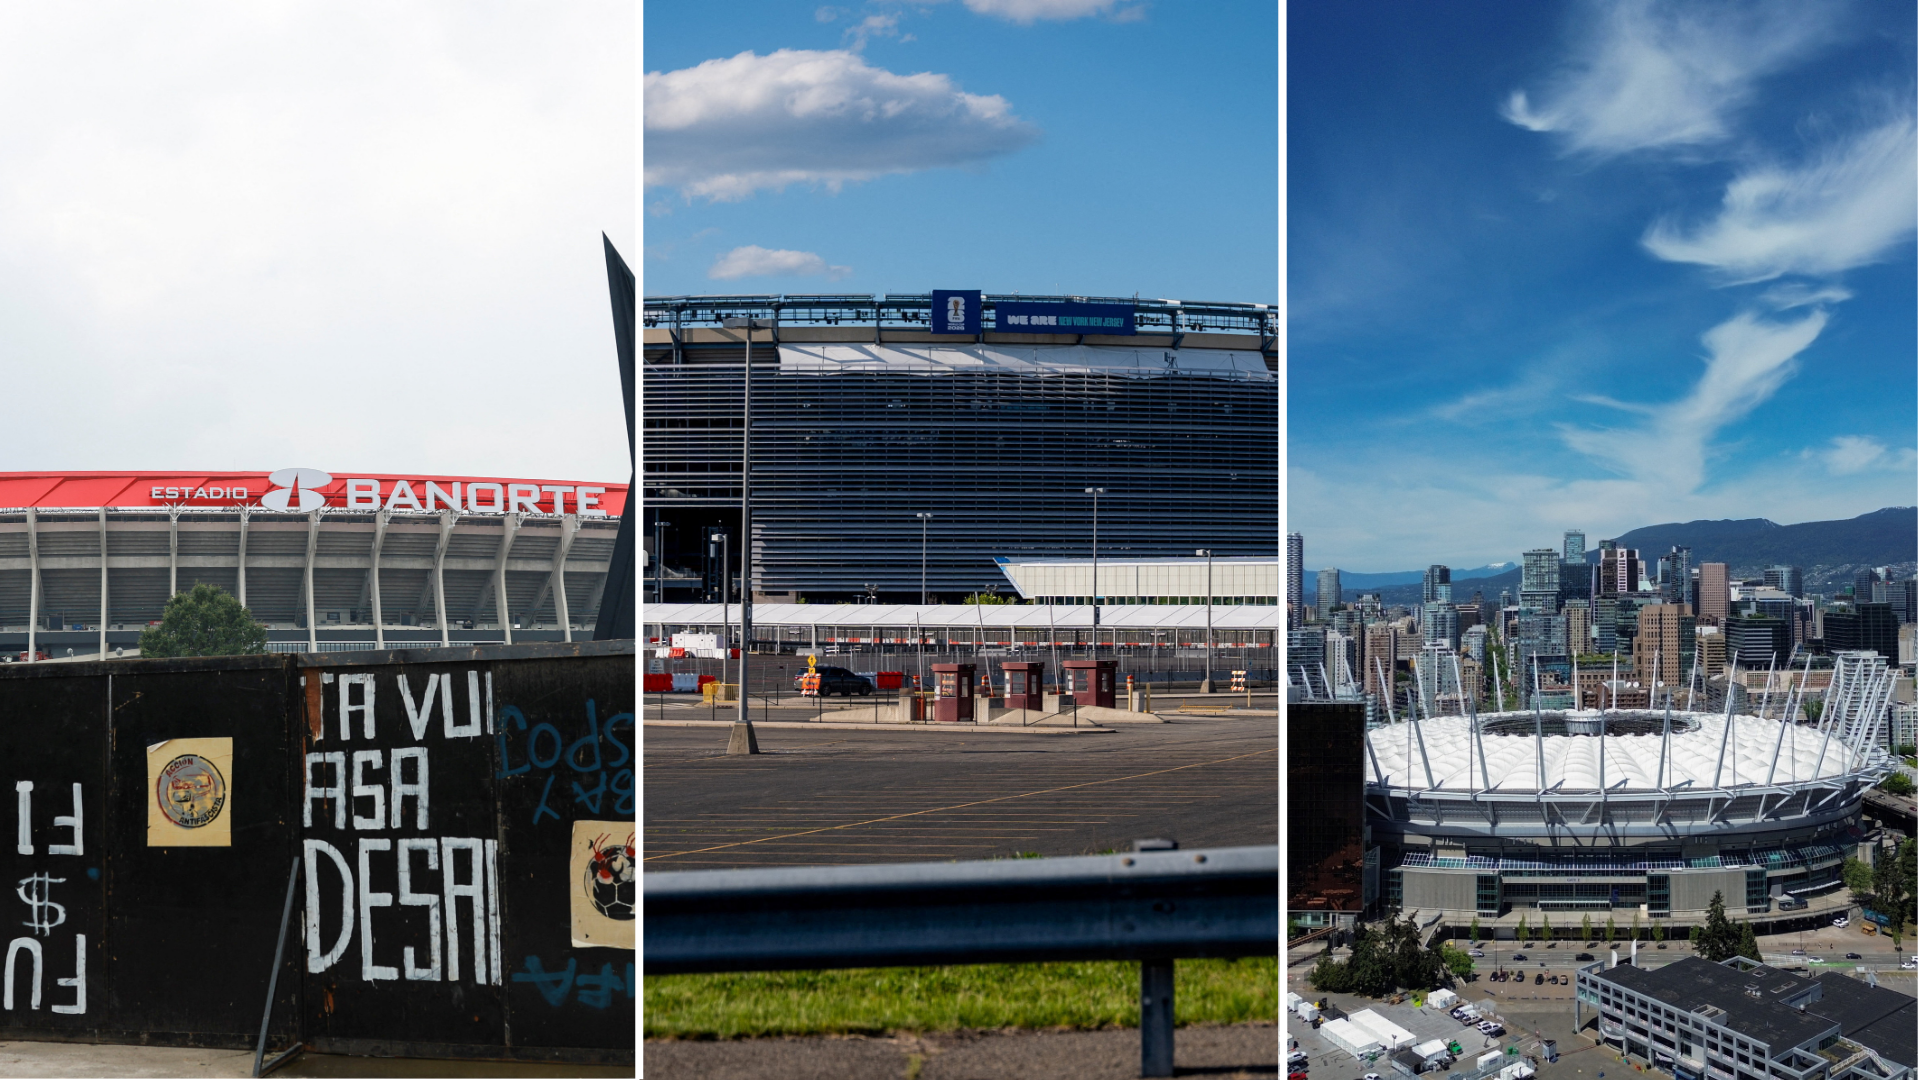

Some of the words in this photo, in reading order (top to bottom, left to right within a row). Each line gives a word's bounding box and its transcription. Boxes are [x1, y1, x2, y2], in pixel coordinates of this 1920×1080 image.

[1007, 315, 1028, 325] WE
[1030, 315, 1057, 326] ARE
[1059, 316, 1072, 326] NEW
[1073, 316, 1088, 326] YORK
[1089, 317, 1102, 327] NEW
[1103, 317, 1124, 327] JERSEY
[151, 486, 248, 500] ESTADIO
[346, 479, 608, 517] BANORTE
[303, 747, 430, 830] ASA
[179, 797, 222, 825] ANTIFASCISTA
